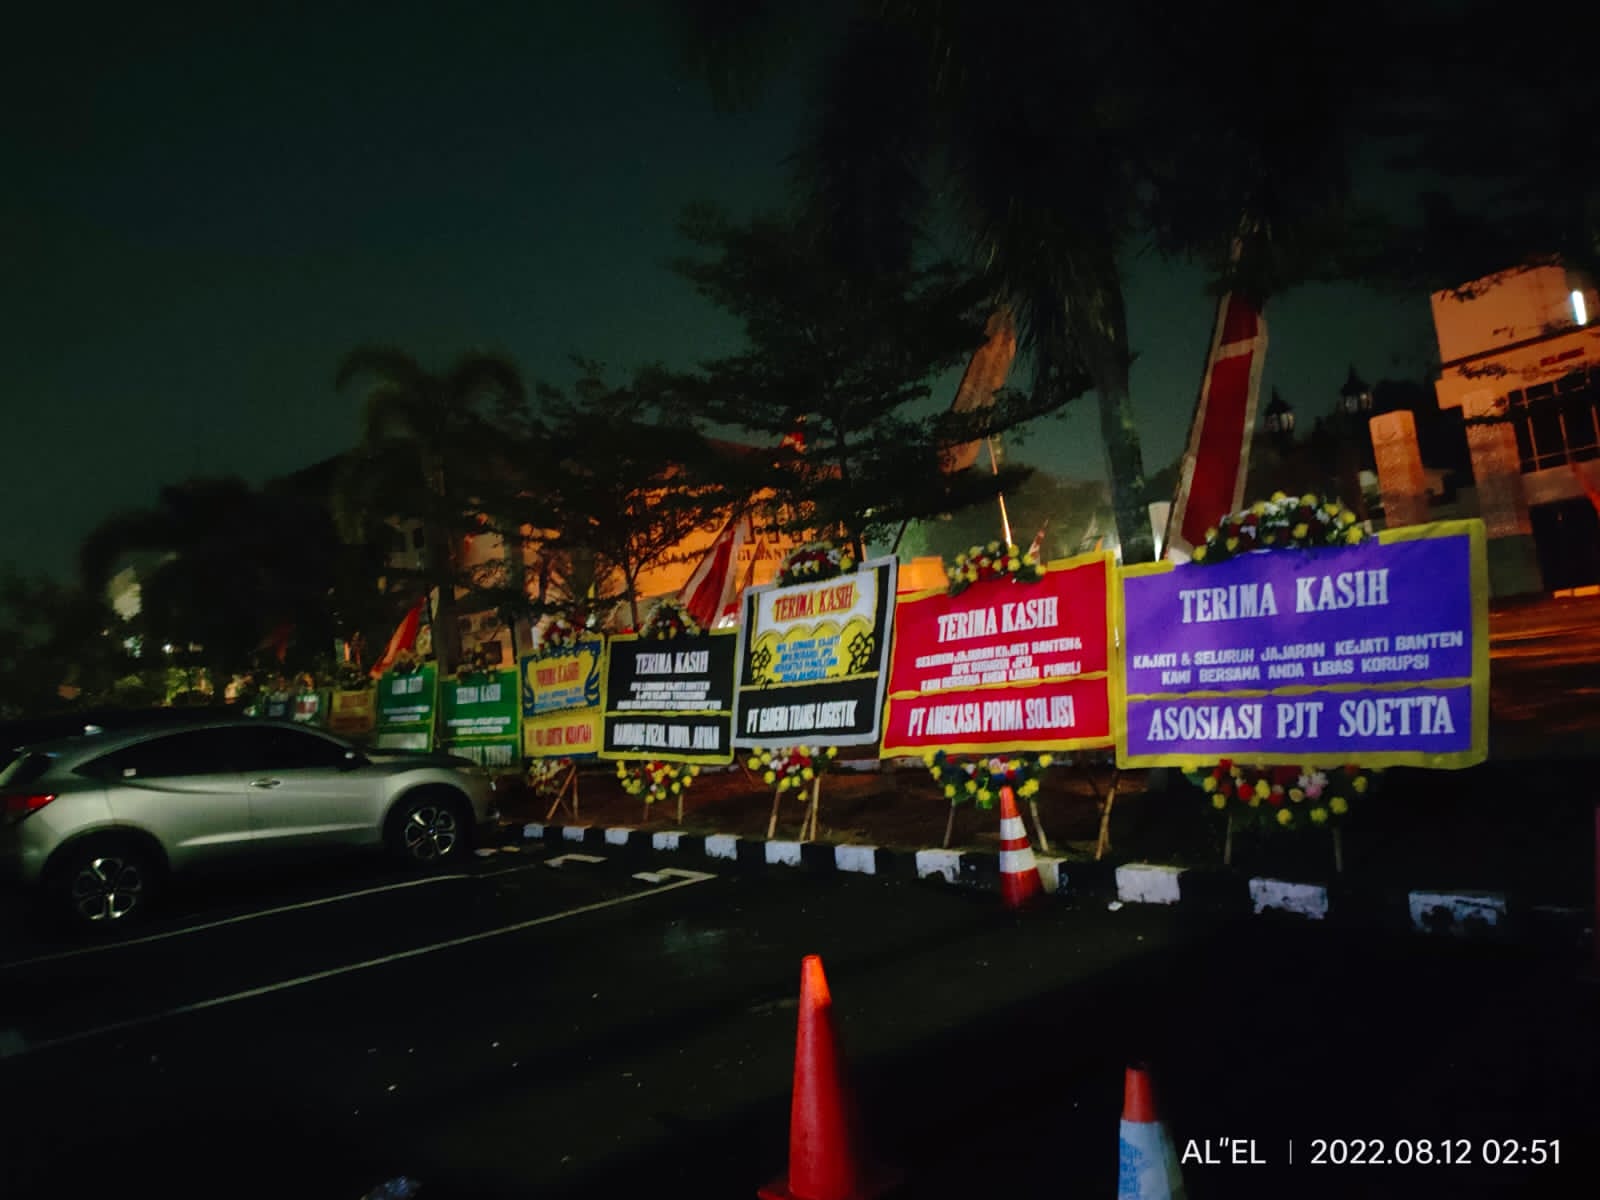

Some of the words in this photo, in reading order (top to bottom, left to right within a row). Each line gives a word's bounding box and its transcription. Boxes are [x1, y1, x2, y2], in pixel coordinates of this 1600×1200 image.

[774, 593, 813, 622] TERIMA
[819, 584, 854, 611] KASIH
[1179, 583, 1278, 624] TERIMA
[1296, 568, 1390, 614] KASIH
[937, 607, 998, 642] TERIMA
[1002, 596, 1058, 633] KASIH
[635, 653, 672, 675] TERIMA
[674, 650, 709, 674] KASIH
[1133, 653, 1176, 670] KAJATI
[1181, 654, 1191, 667] &
[1194, 648, 1255, 665] SELURUH
[1260, 643, 1325, 662] JAJARAN
[1335, 637, 1389, 657] KEJATI
[1395, 631, 1463, 651] BANTEN
[1161, 670, 1191, 685] KAMI
[1199, 666, 1260, 682] BERSAMA
[1268, 663, 1304, 680] ANDA
[1313, 659, 1354, 677] LIBAS
[1361, 655, 1429, 673] KORUPSI
[907, 707, 926, 737] PT
[925, 702, 981, 736] ANGKASA
[983, 698, 1024, 733] PRIMA
[1025, 695, 1076, 731] SOLUSI
[1147, 704, 1263, 742] ASOSIASI
[1276, 702, 1323, 740] PJT
[1338, 696, 1456, 738] SOETTA
